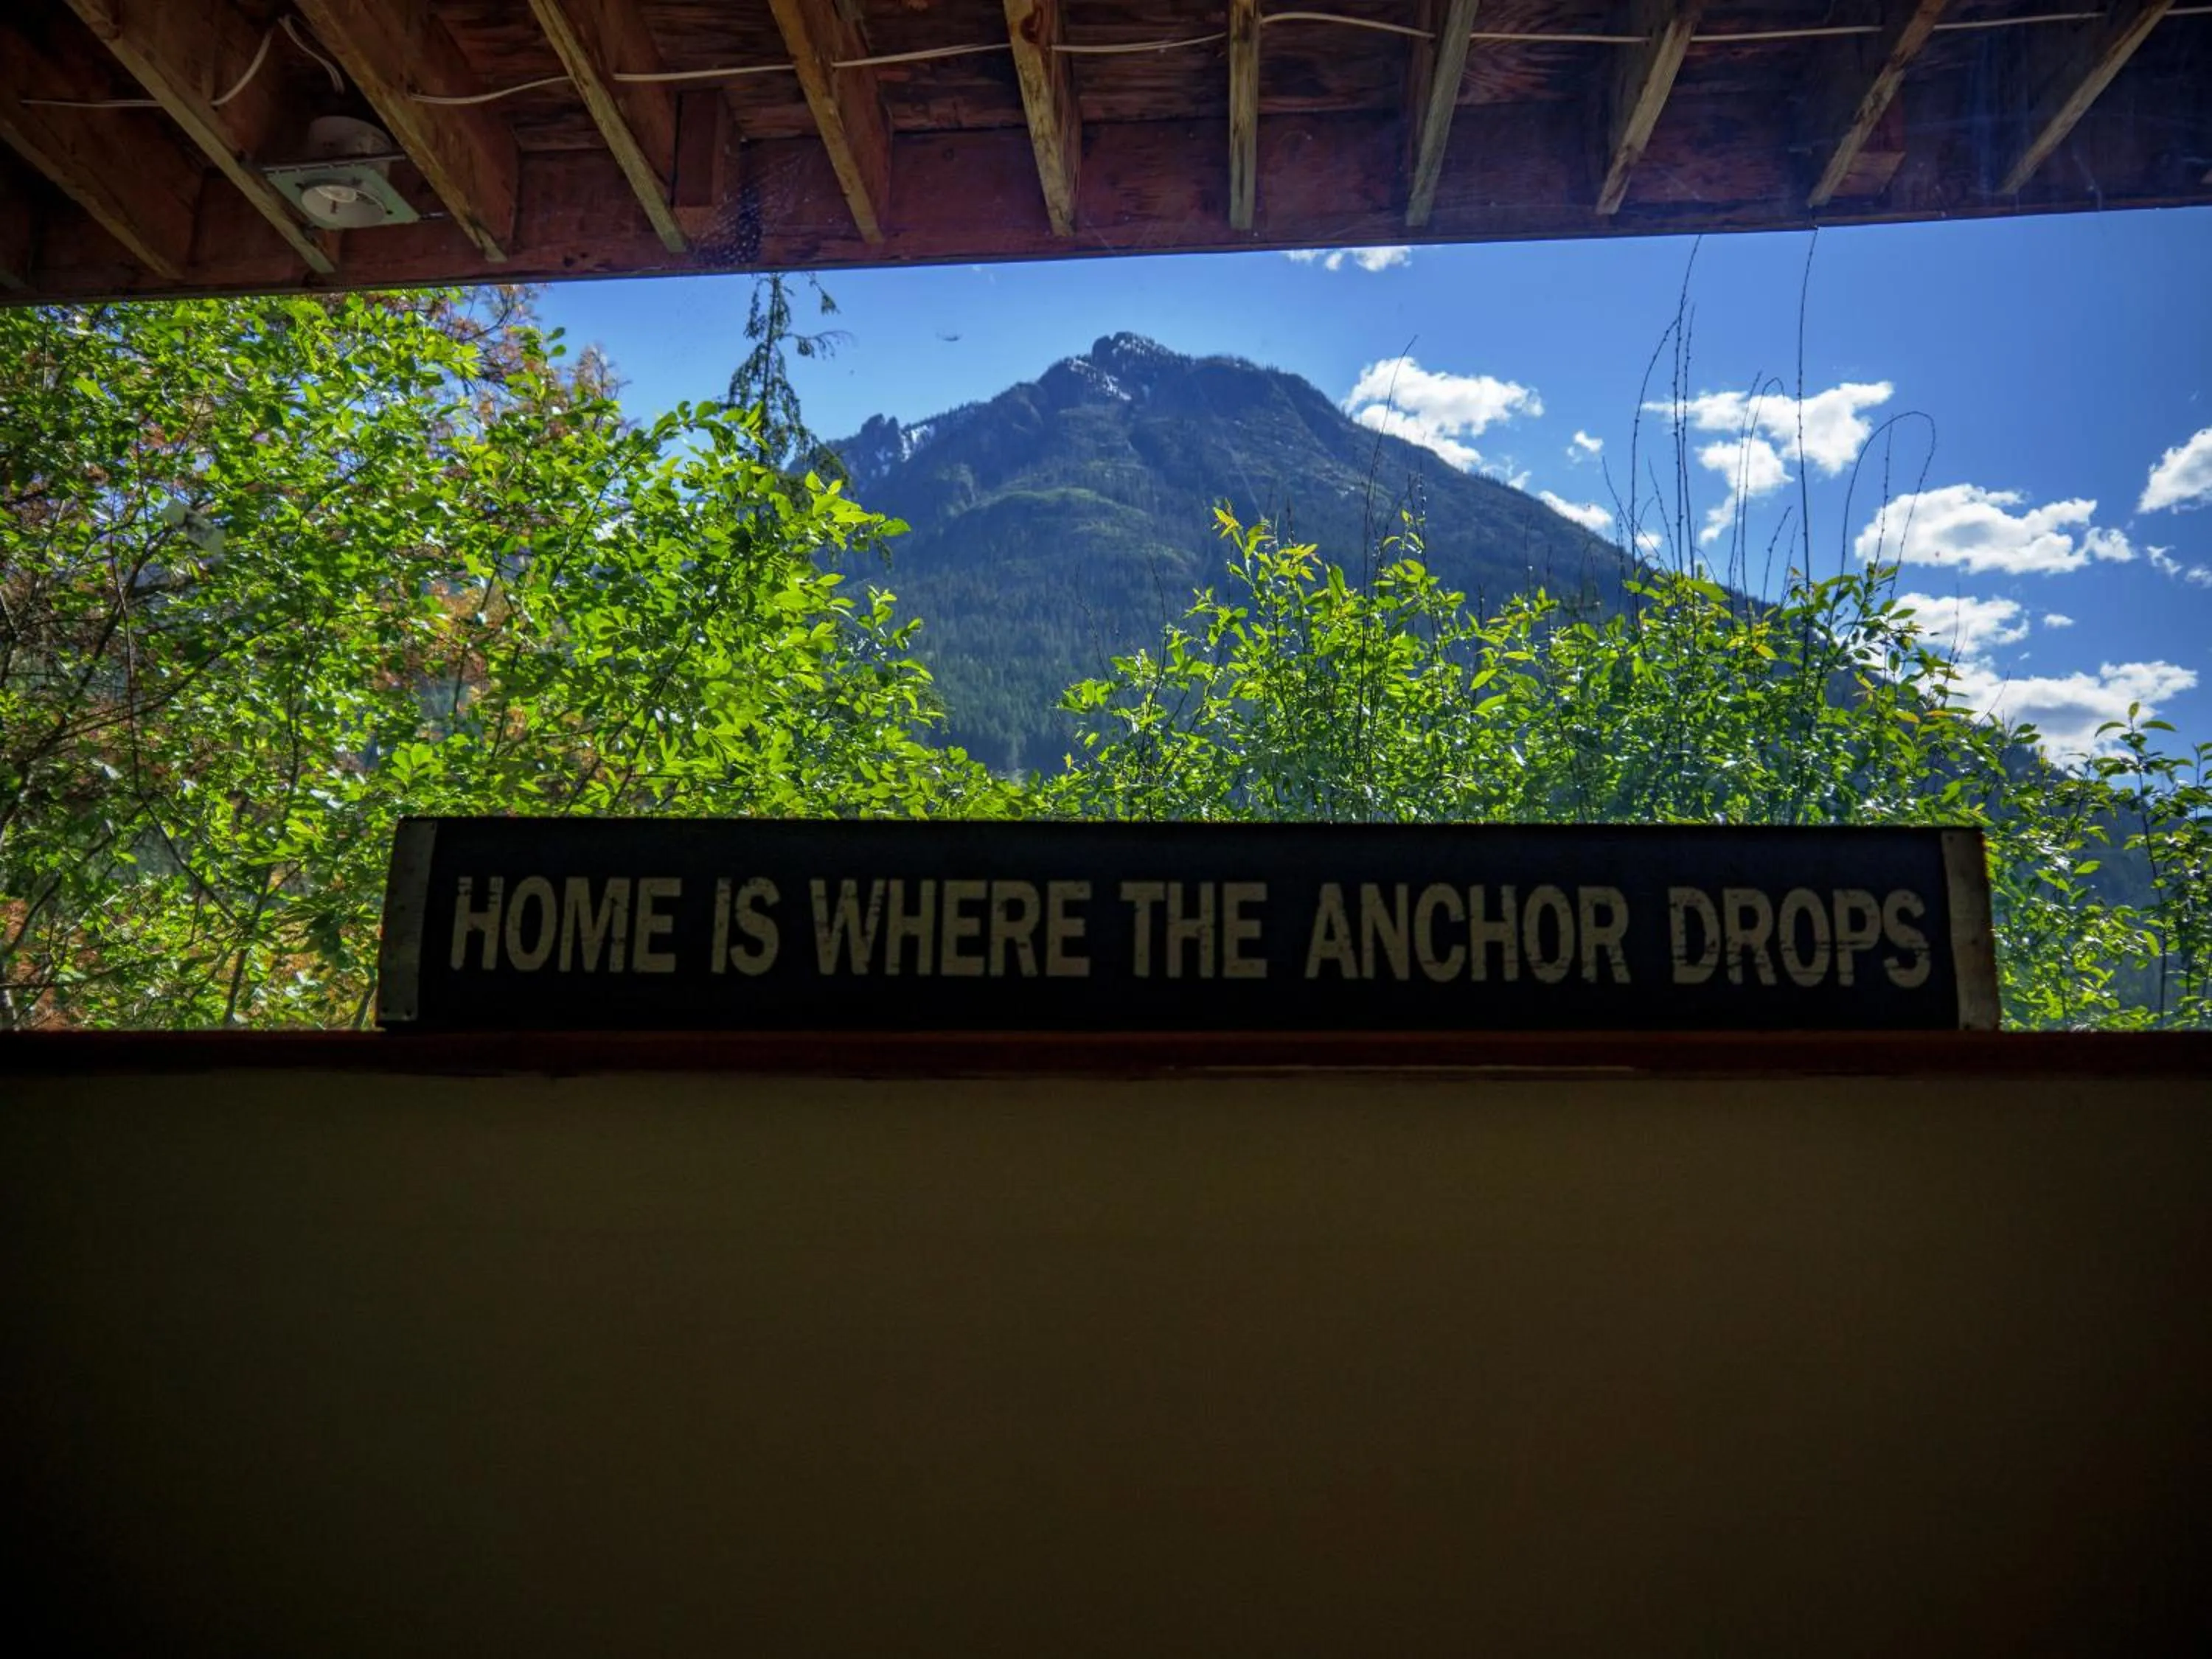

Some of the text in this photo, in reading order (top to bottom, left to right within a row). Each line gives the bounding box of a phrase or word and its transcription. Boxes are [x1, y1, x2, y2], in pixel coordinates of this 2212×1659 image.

[451, 876, 1931, 988] HOME IS WHERE THE ANCHOR DROPS
